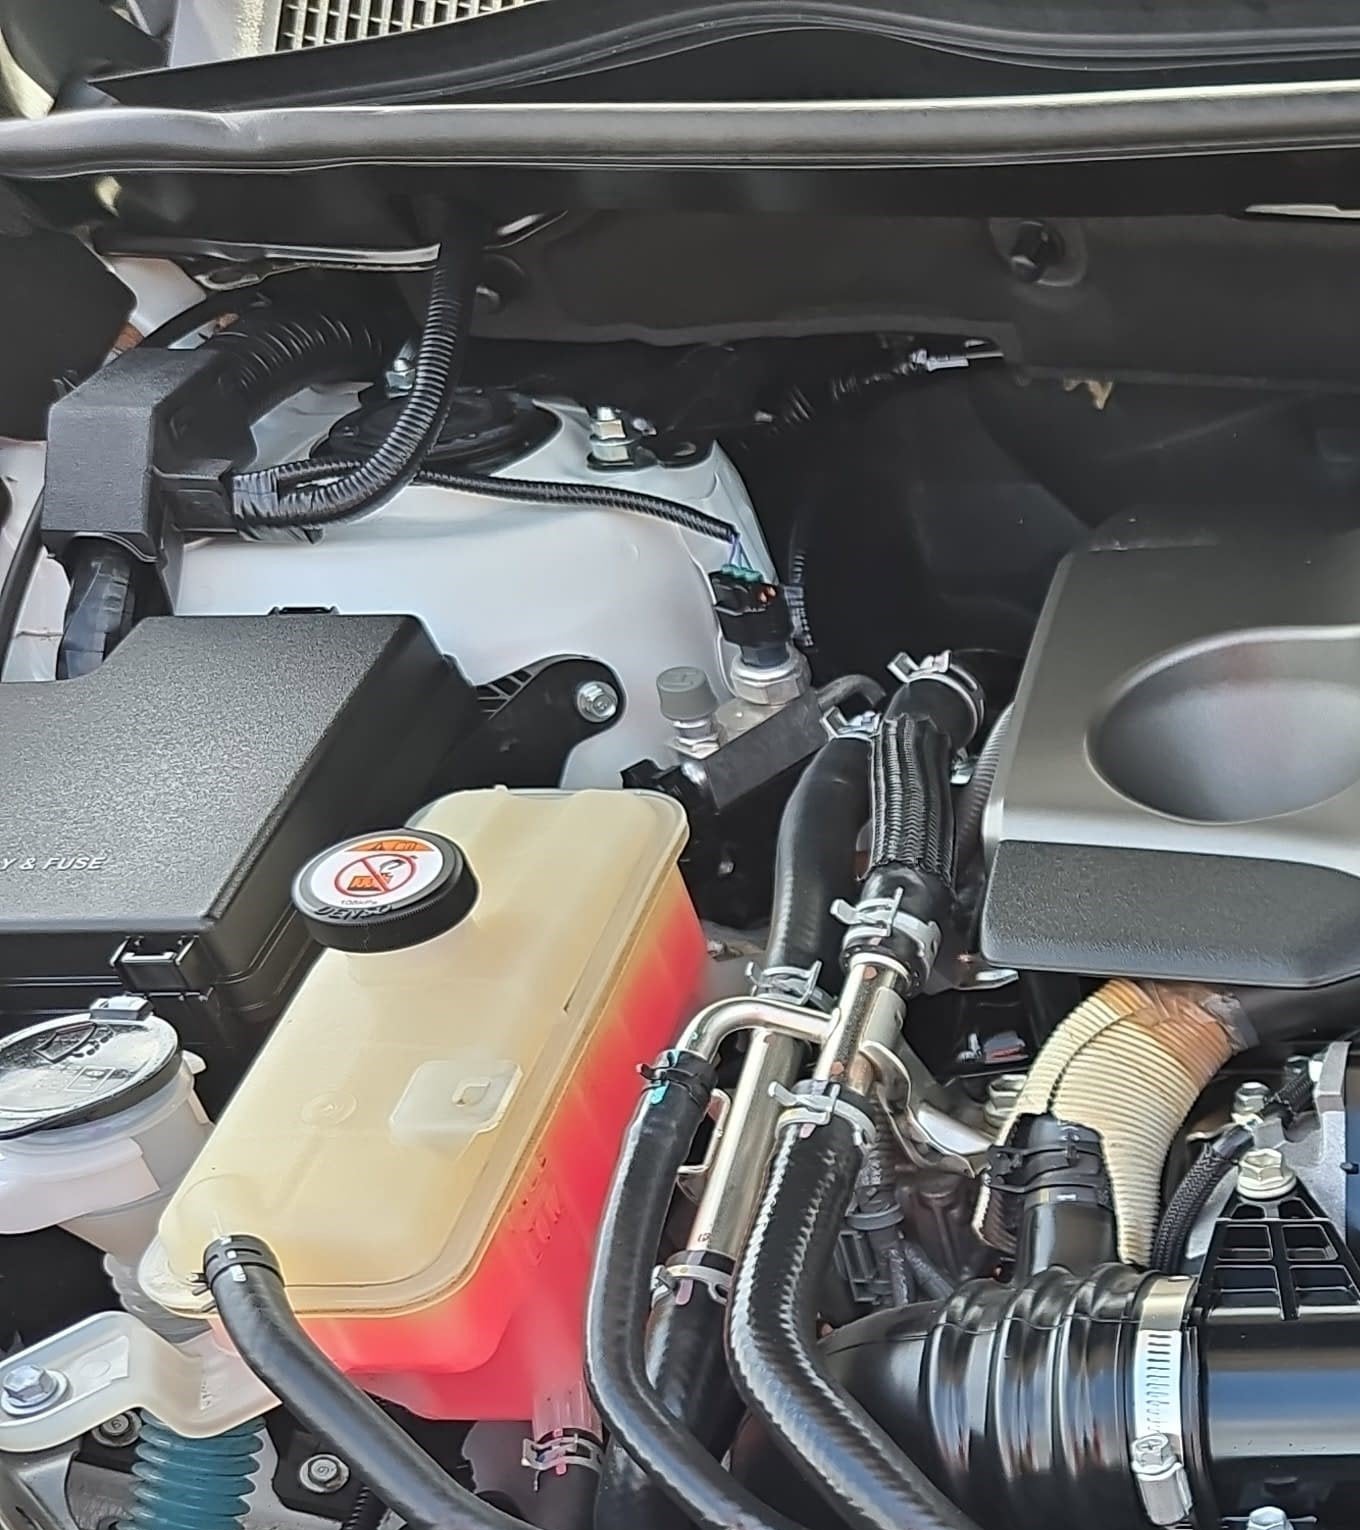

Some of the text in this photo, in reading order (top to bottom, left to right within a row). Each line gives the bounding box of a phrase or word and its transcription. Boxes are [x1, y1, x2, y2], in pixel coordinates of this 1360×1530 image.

[20, 857, 37, 871] &
[42, 856, 107, 871] FUSE
[314, 904, 392, 921] DENSO
